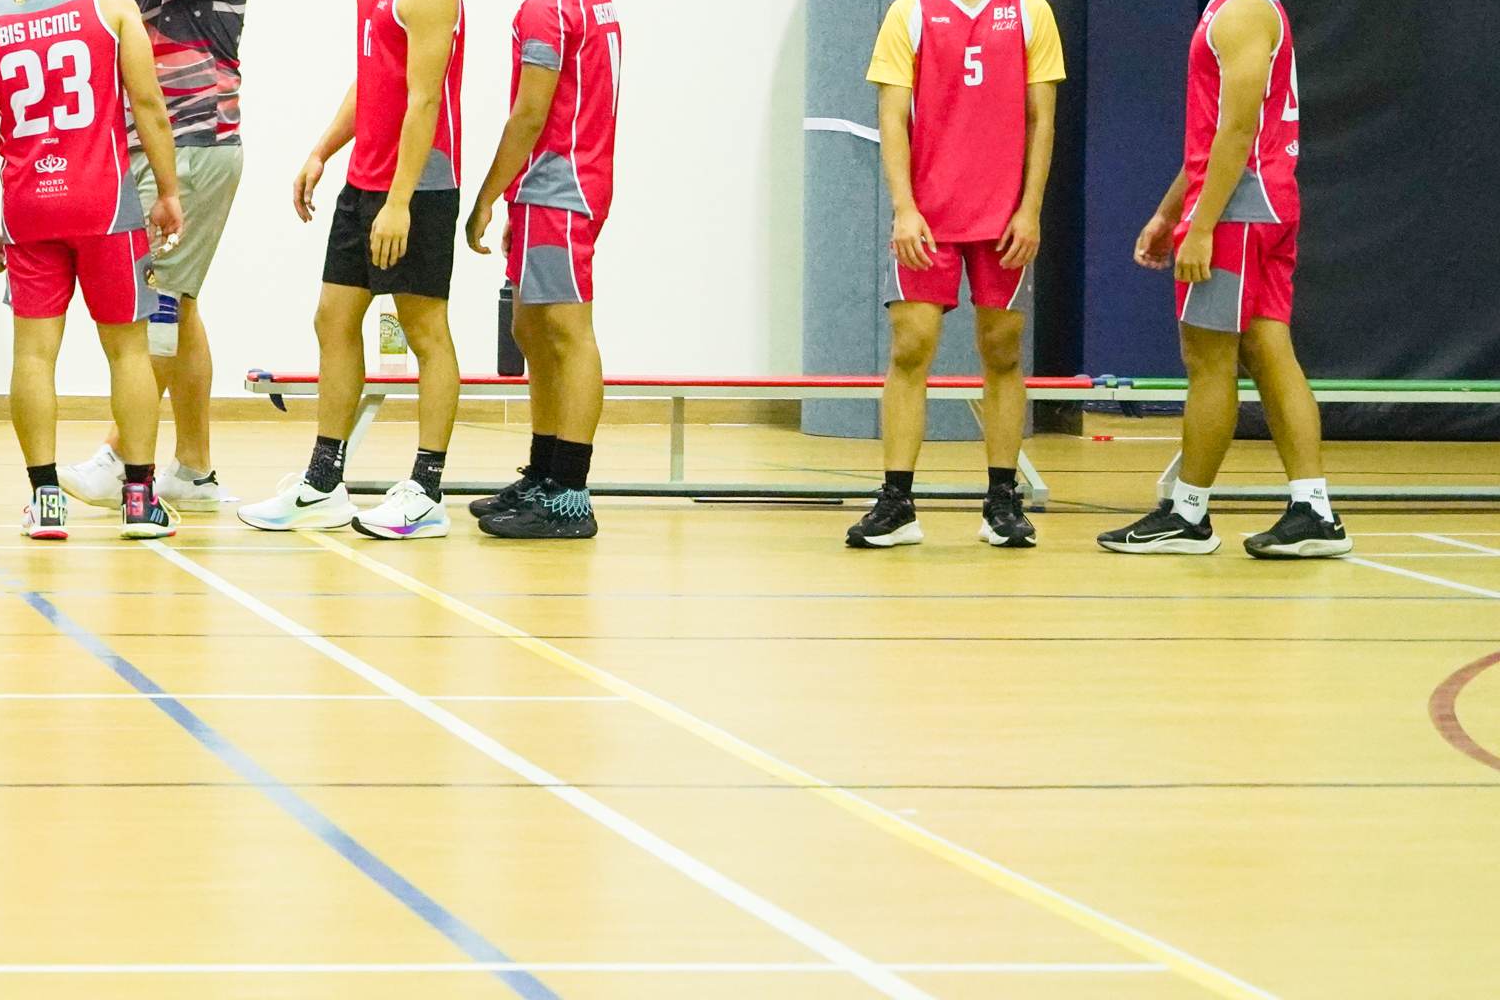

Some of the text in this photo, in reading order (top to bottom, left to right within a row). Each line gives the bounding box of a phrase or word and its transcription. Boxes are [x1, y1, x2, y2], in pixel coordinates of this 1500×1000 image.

[28, 11, 80, 40] HCMC
[994, 6, 1017, 20] BIS
[964, 46, 984, 87] 5
[0, 39, 95, 138] 23
[35, 184, 69, 193] ANGLIA
